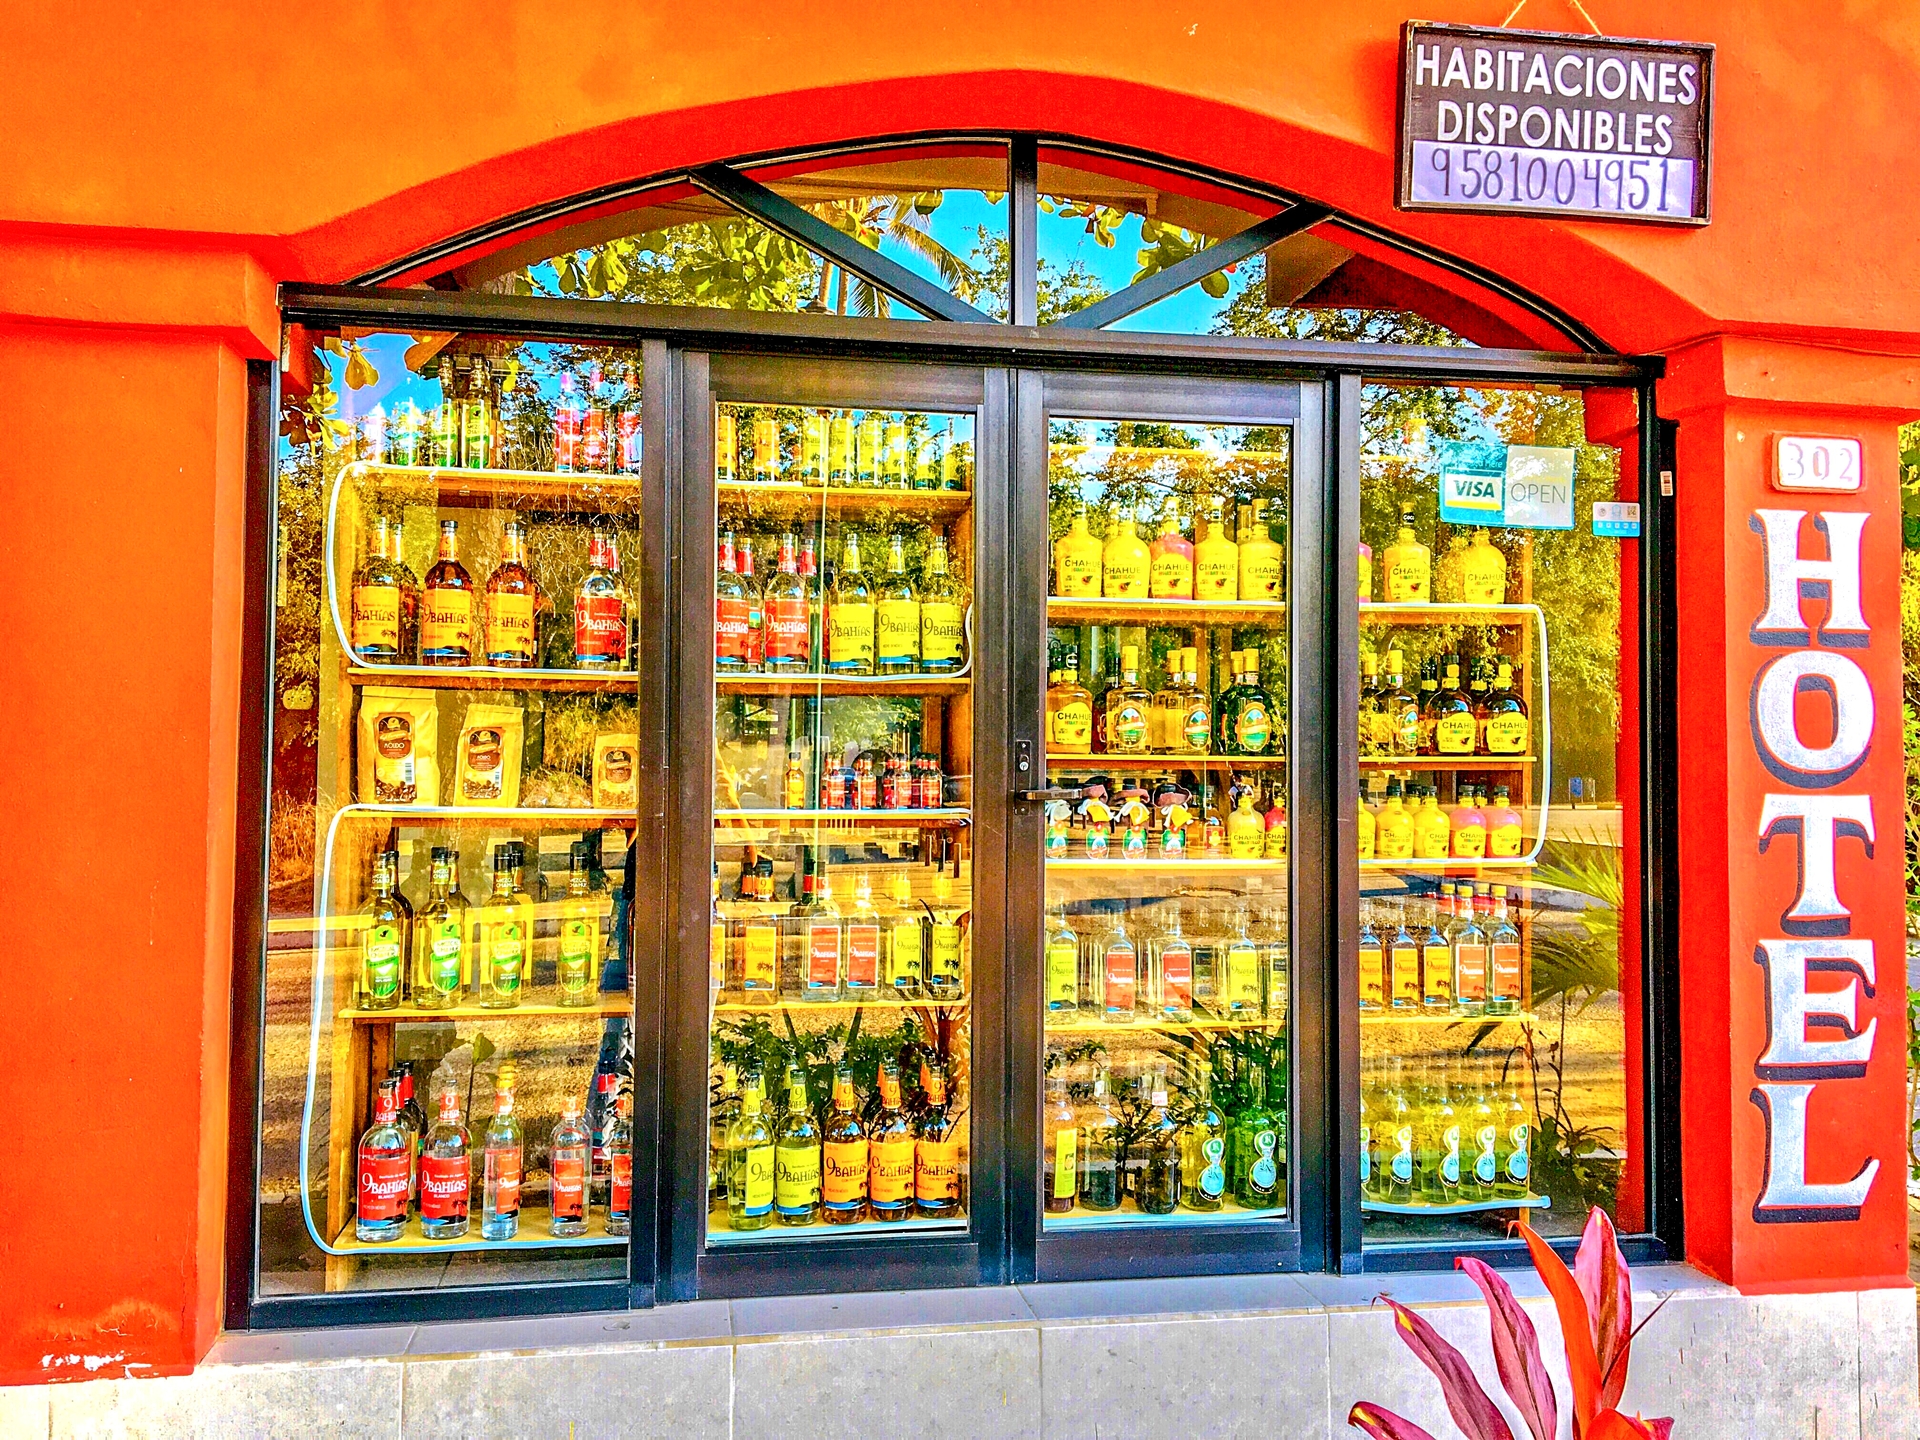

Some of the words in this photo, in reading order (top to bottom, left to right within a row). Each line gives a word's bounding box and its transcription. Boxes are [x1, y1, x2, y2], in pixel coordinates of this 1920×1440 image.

[1416, 44, 1697, 105] HABITACIONES
[1437, 100, 1673, 155] DISPONIBLES
[1432, 147, 1669, 212] 9581004951
[1787, 441, 1854, 482] 302
[1453, 480, 1495, 498] VISA
[1510, 482, 1566, 504] OPEN
[1064, 559, 1100, 568] CHAHUE
[1104, 567, 1140, 575] CHAHUE
[1248, 567, 1283, 575] CHAHUE
[1057, 712, 1091, 721] CHAHUE
[1442, 721, 1477, 729] CHAHUE
[1492, 721, 1528, 729] CHAHUE
[1750, 509, 1880, 1223] HOTEL
[795, 1087, 804, 1101] 9
[843, 1087, 852, 1099] 9
[889, 1084, 897, 1097] 9
[934, 1081, 943, 1094] 9
[383, 1098, 393, 1112] 9
[445, 1096, 455, 1110] 9
[362, 1172, 408, 1195] 9BAHÍAS
[422, 1170, 468, 1193] 9BAHÍAS
